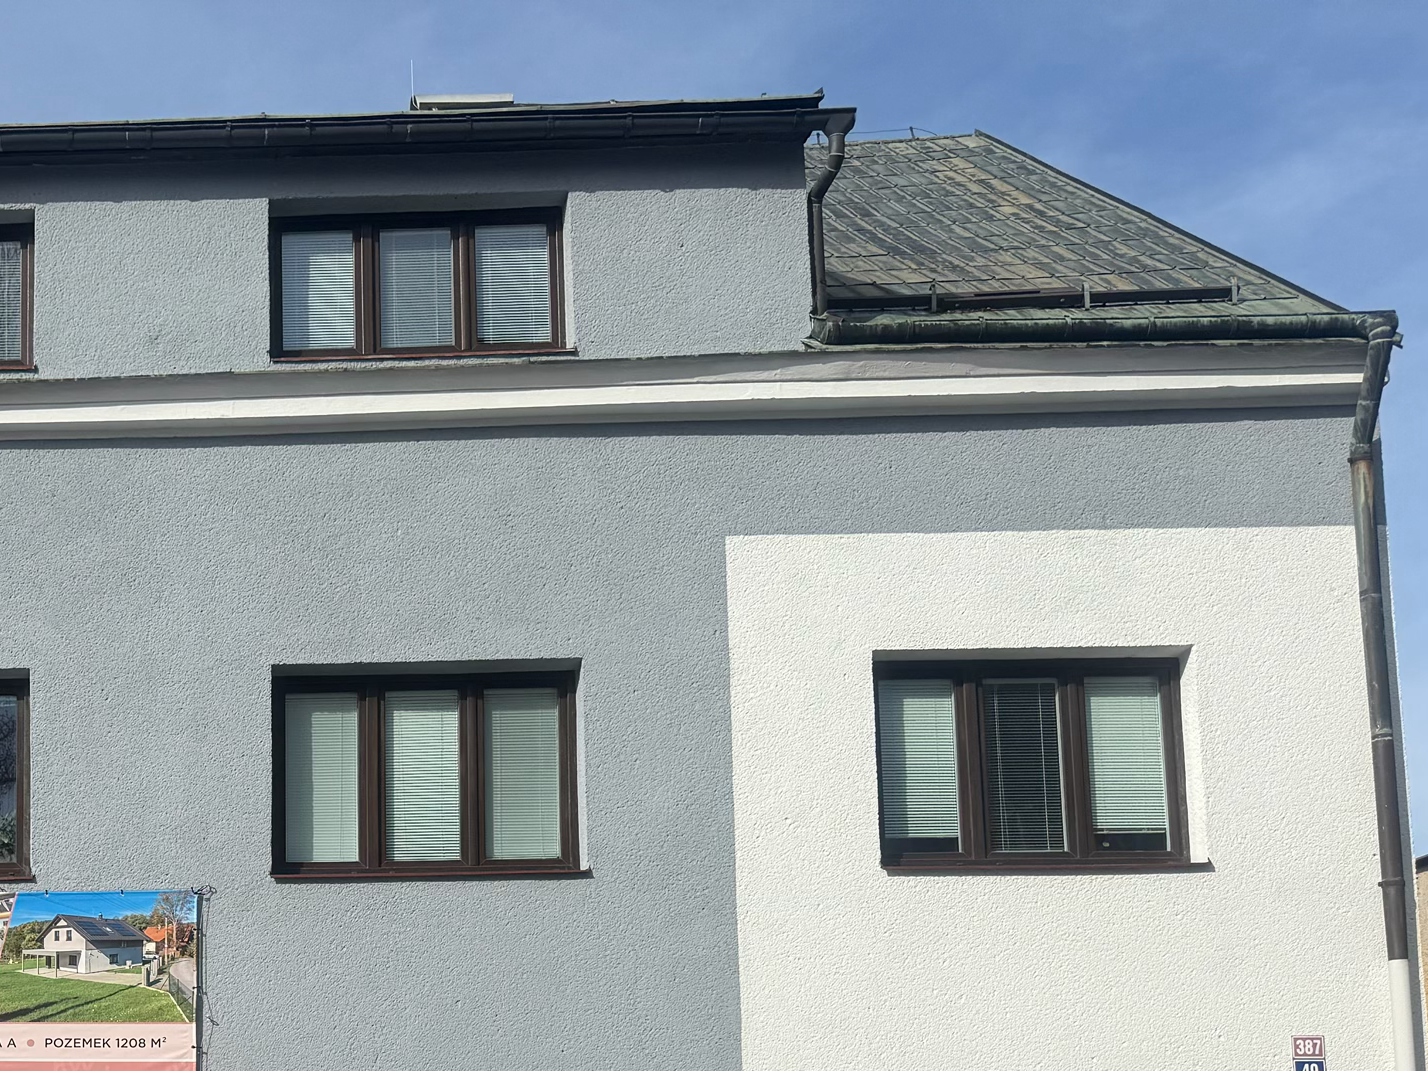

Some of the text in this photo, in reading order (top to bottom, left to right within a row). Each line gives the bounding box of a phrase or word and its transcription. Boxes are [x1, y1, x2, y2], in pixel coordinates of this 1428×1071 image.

[6, 1037, 17, 1048] A
[44, 1037, 111, 1049] POZEMEK
[115, 1038, 146, 1048] 1208
[1295, 1039, 1321, 1055] 387
